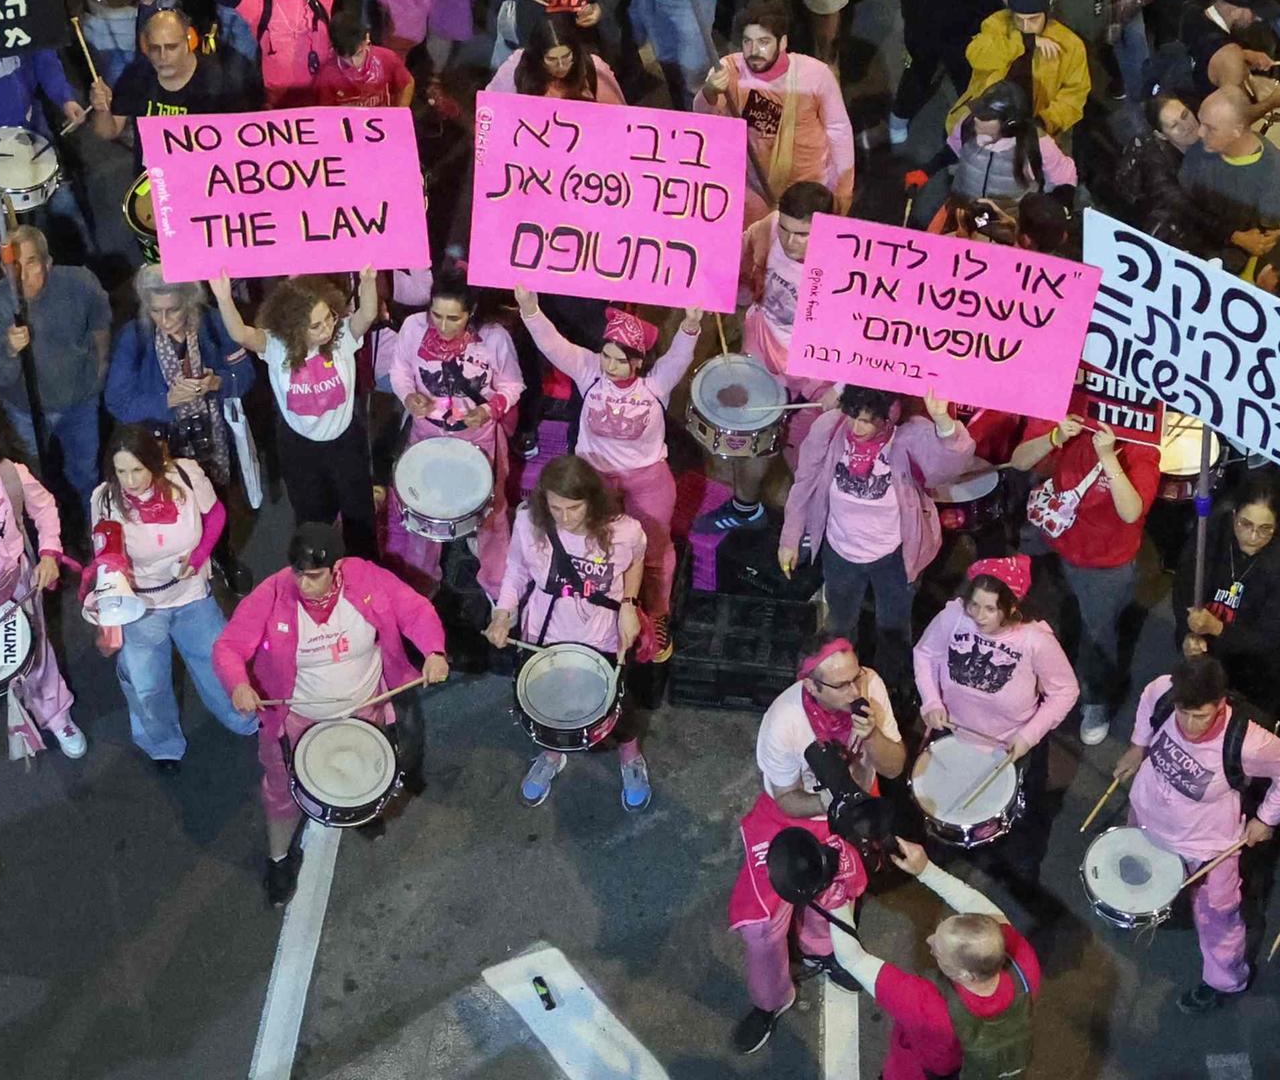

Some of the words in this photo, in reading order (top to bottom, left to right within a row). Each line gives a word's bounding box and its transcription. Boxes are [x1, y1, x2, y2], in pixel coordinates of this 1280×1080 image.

[162, 124, 223, 155] NO
[237, 117, 320, 148] ONE
[342, 116, 387, 143] IS
[512, 110, 581, 154] לא
[626, 123, 711, 169] ביבי
[207, 156, 347, 198] ABOVE
[486, 161, 553, 200] את
[641, 172, 730, 223] סופר
[189, 211, 277, 248] THE
[301, 201, 389, 242] LAW
[509, 222, 698, 289] החטופים
[836, 231, 928, 270] לדור
[952, 249, 988, 281] לו
[831, 269, 901, 302] את
[802, 342, 841, 366] רבה
[288, 383, 312, 395] PINK
[1098, 401, 1155, 433] נולדו
[999, 642, 1023, 661] BACK
[1161, 736, 1206, 779] VICTORY
